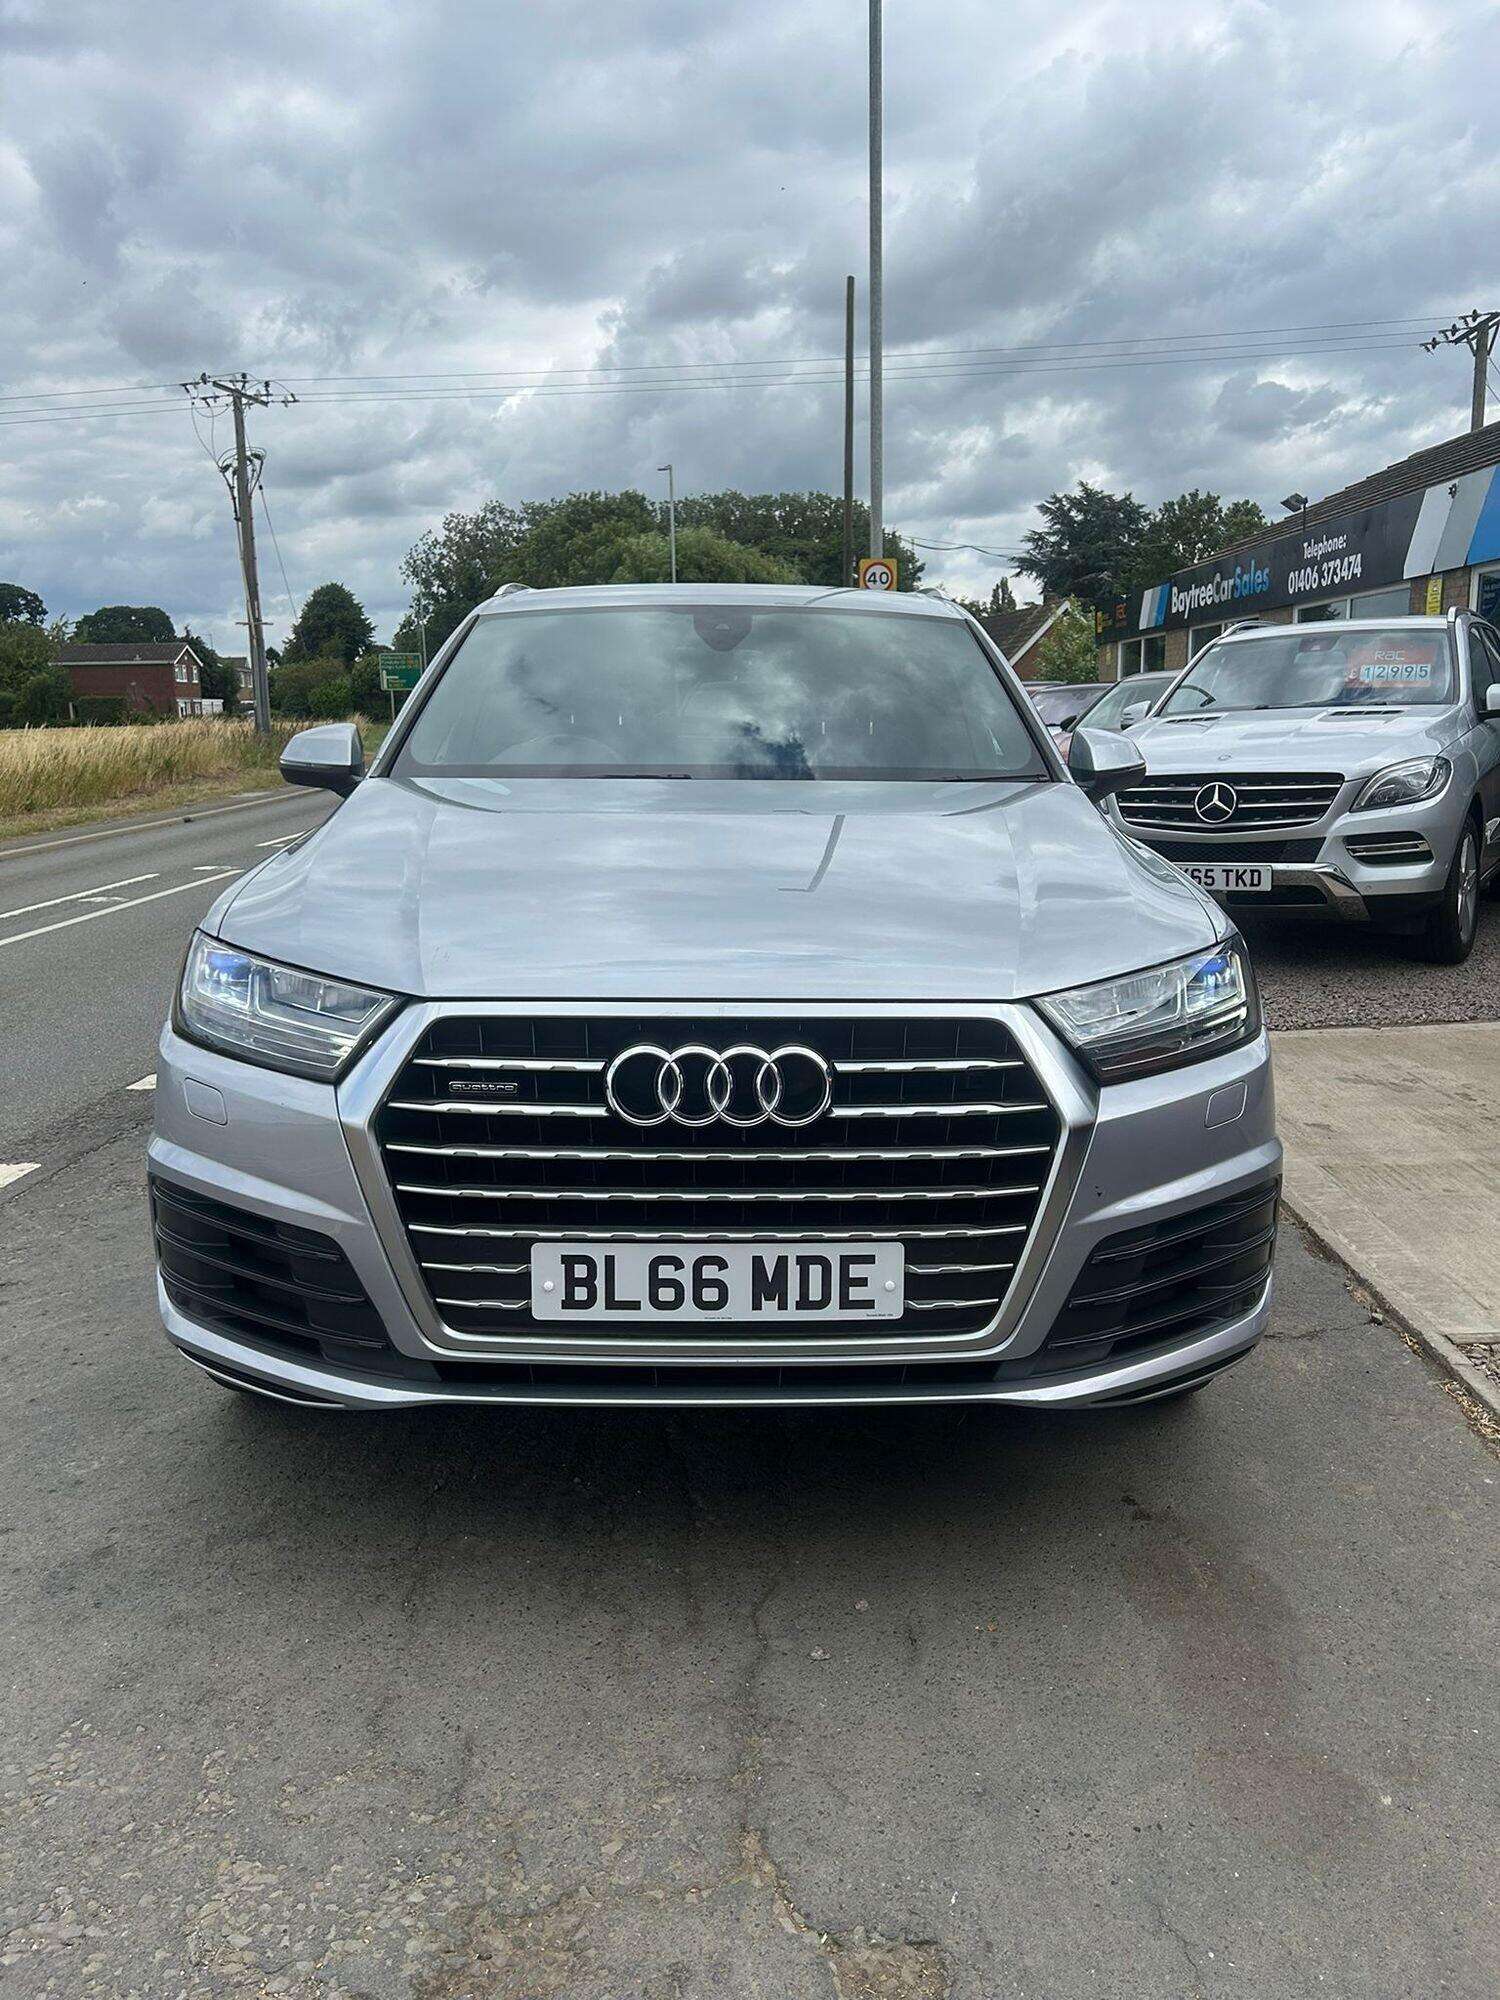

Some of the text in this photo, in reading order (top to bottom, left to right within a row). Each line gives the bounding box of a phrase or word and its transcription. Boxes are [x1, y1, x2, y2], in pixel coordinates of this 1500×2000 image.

[1303, 534, 1347, 560] Telephone:
[867, 571, 890, 585] 40
[1287, 553, 1362, 594] 01406 373474
[1221, 868, 1262, 888] TKD
[451, 1083, 515, 1092] quattro
[560, 1254, 876, 1311] BL66 MDE
